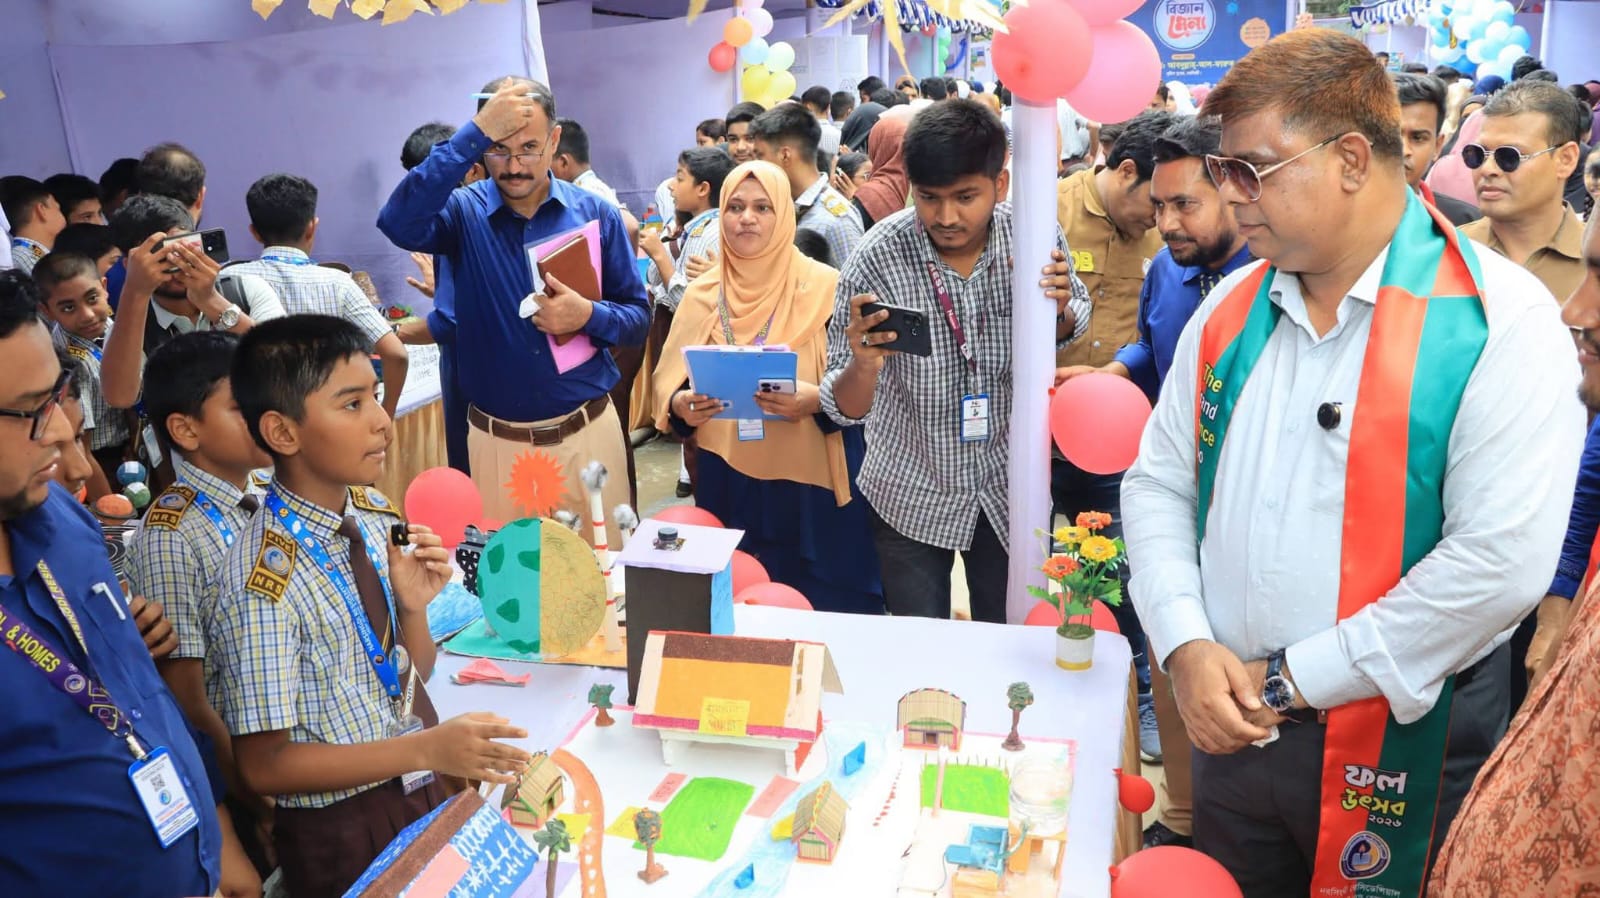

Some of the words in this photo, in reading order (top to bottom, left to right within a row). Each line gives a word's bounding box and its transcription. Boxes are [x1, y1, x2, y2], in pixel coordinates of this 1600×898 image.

[1166, 0, 1204, 15] বিজ্ঞান
[1168, 15, 1207, 39] মেলা
[1204, 363, 1223, 393] The
[151, 512, 178, 524] NRS
[253, 573, 283, 595] NRS
[6, 624, 20, 640] &
[16, 632, 61, 673] HOMES
[1344, 765, 1408, 794] ফল
[1341, 788, 1406, 816] উৎসব
